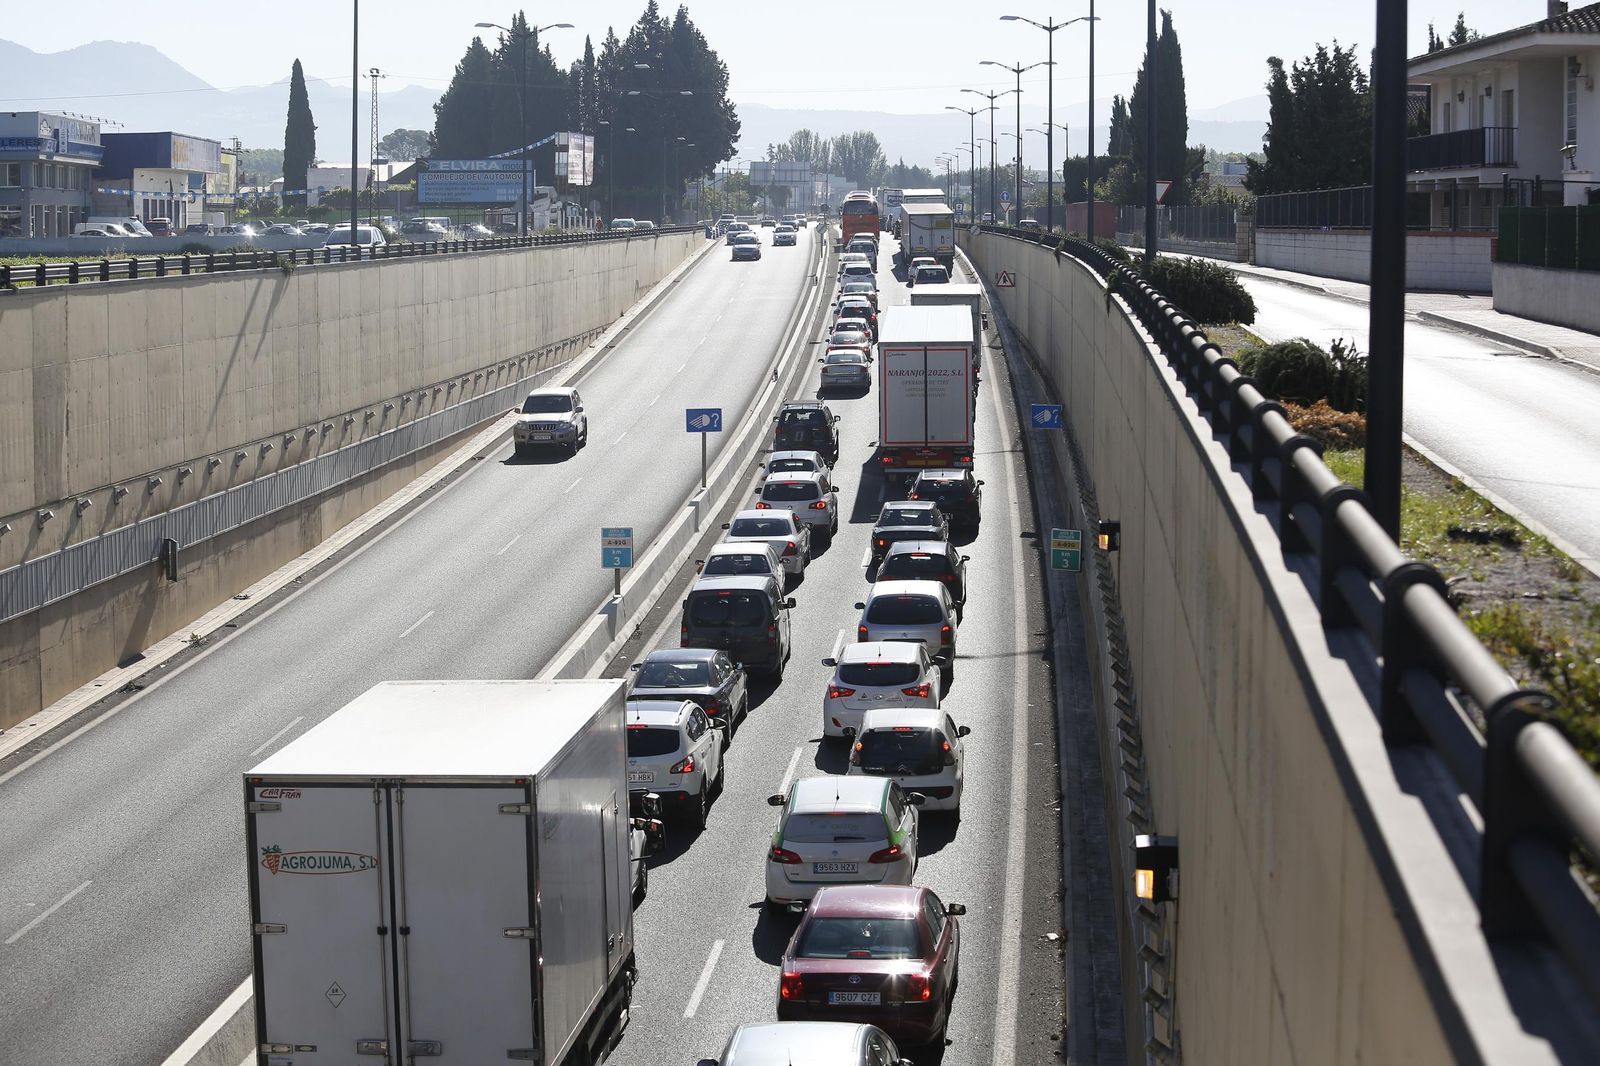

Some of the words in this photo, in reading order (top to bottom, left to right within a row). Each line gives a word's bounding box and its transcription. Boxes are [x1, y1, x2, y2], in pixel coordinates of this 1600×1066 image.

[440, 160, 500, 170] ELVIRA
[422, 173, 464, 181] COMPLEJO
[467, 173, 481, 181] DEL
[888, 369, 925, 377] NARANJO
[928, 369, 950, 377] 2022,
[613, 556, 621, 566] 3
[1062, 558, 1069, 568] 3
[281, 855, 355, 871] AGROJUMA,
[819, 863, 839, 871] 9563
[841, 863, 856, 871] HZX
[835, 993, 858, 1002] 9607
[861, 993, 879, 1002] CZF
